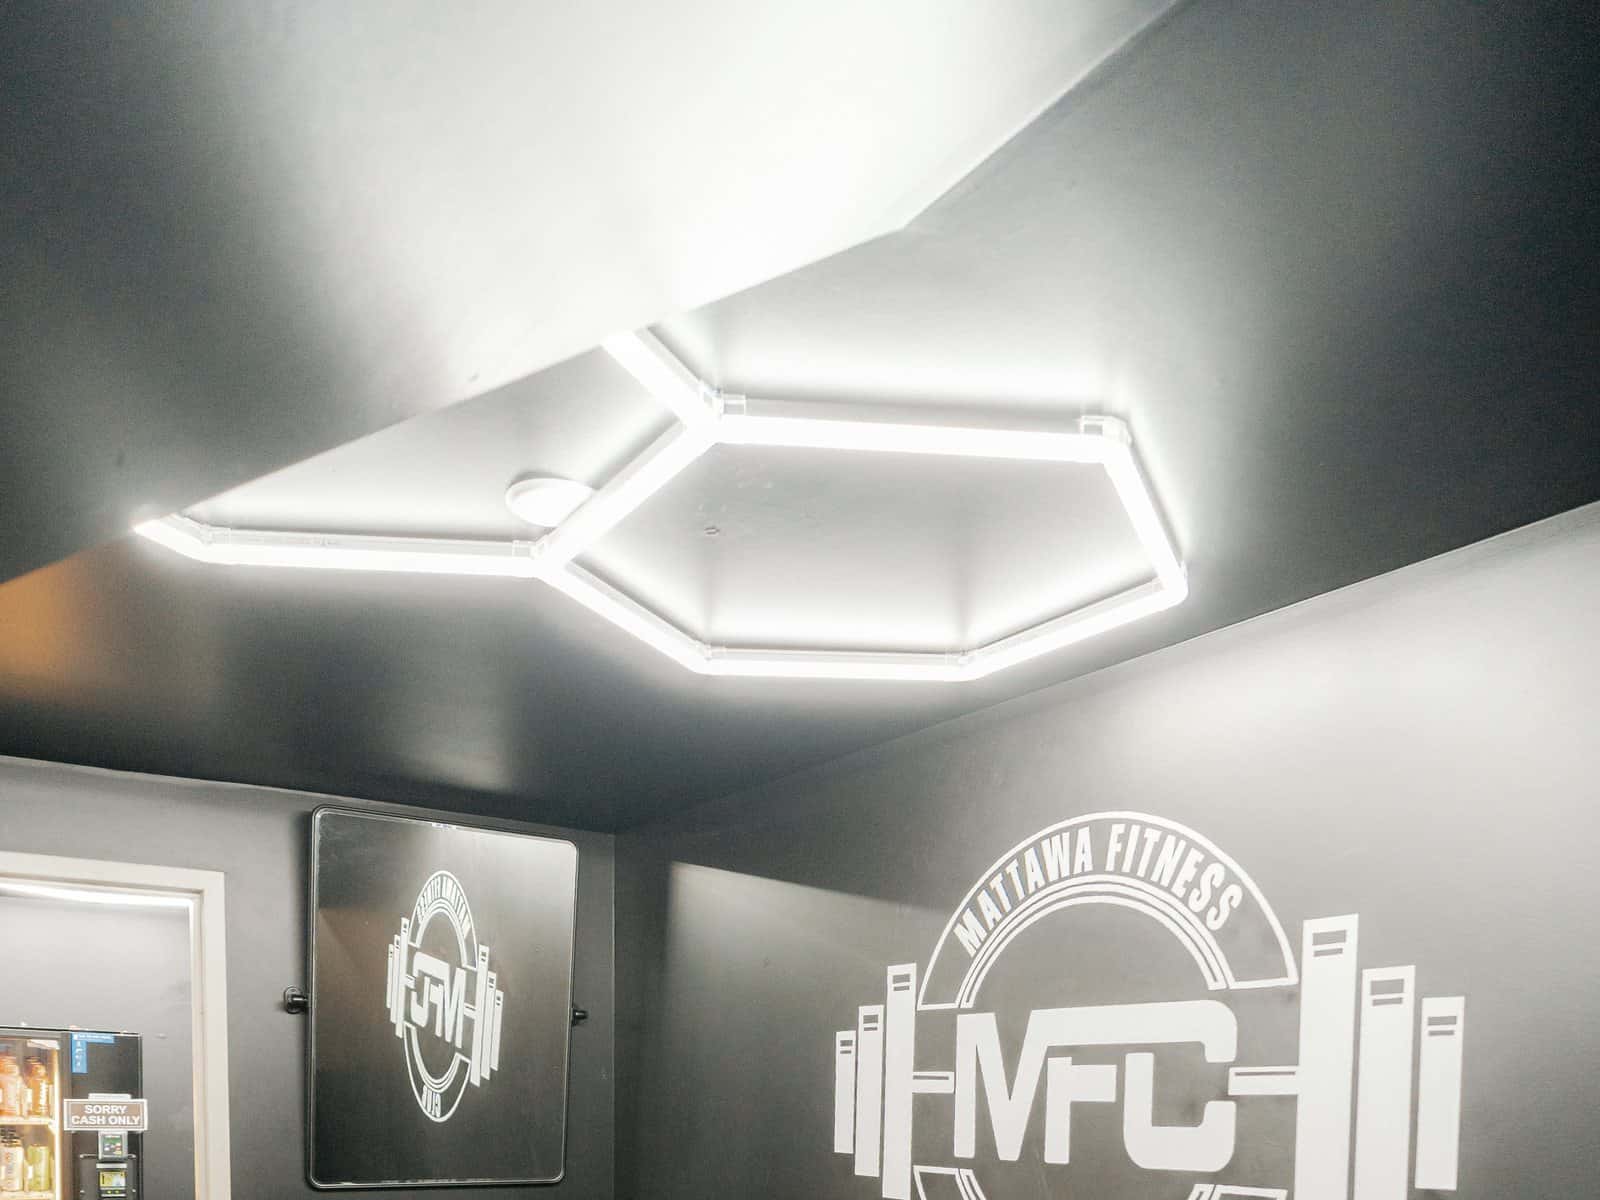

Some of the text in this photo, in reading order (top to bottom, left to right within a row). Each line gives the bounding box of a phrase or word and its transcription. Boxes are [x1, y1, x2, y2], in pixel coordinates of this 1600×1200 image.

[952, 823, 1243, 958] MATTAWA FITNESS
[71, 1115, 140, 1125] CASH ONLY
[84, 1104, 128, 1115] SORRY
[953, 999, 1238, 1173] MFC
